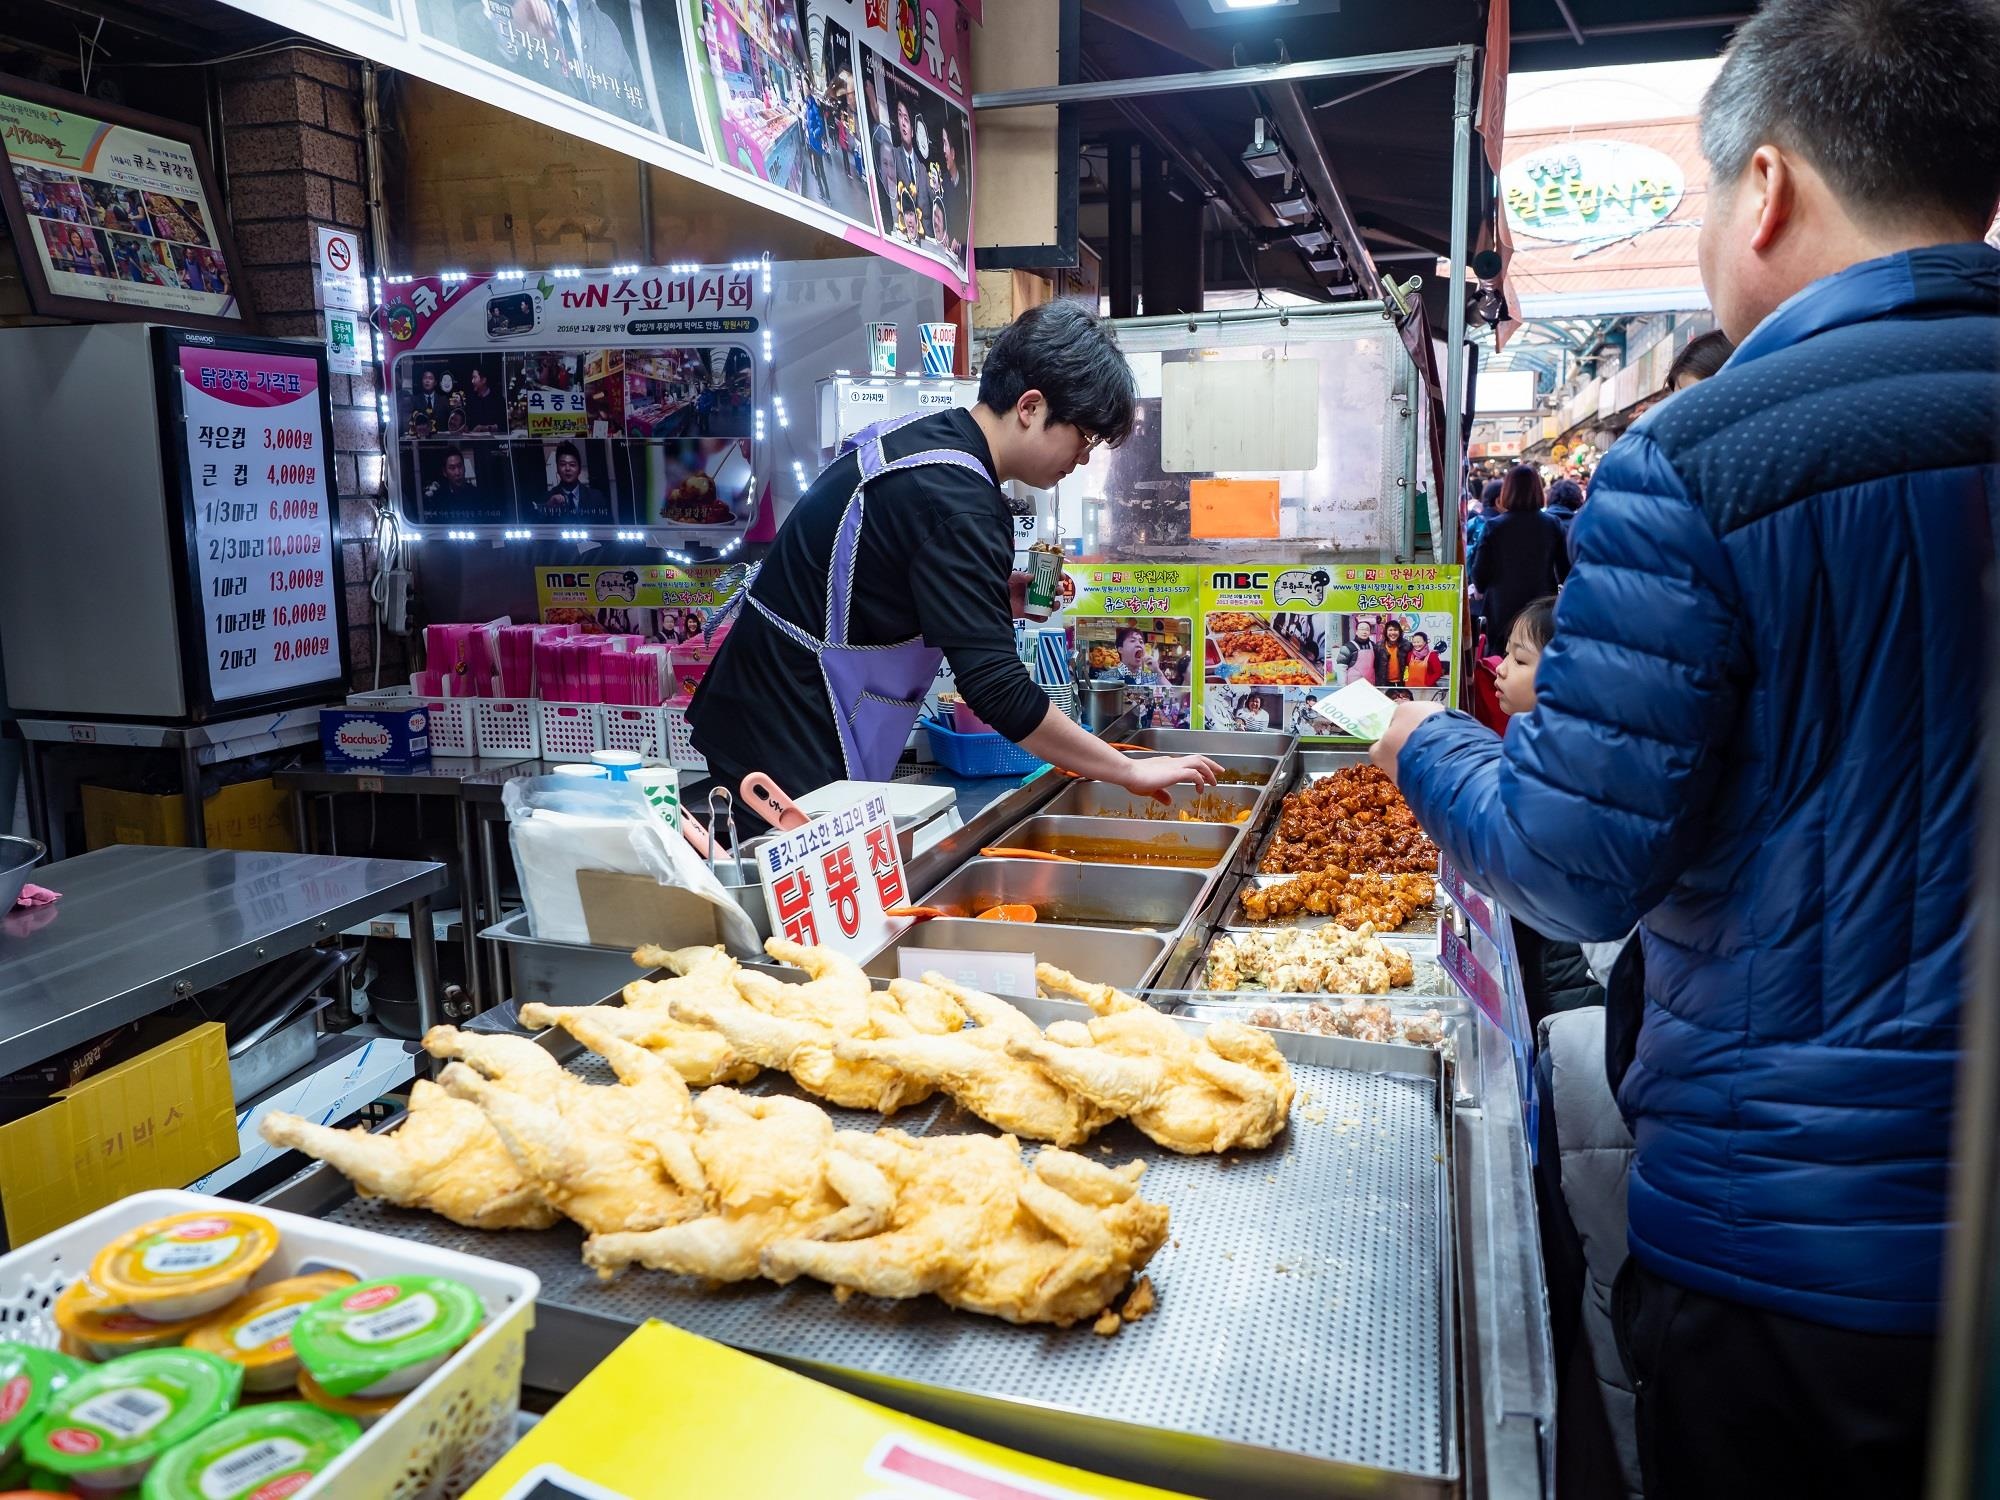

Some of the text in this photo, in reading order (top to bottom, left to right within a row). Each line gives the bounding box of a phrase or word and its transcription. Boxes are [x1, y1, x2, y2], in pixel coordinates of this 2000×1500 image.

[133, 154, 157, 170] 큐스
[160, 160, 193, 180] 닭강정
[1508, 178, 1674, 222] 월드컵시장
[561, 273, 753, 316] tvN 수요미식회
[185, 334, 213, 343] DAEWOO
[557, 324, 580, 333] 2016년
[581, 324, 595, 333] 12월
[597, 323, 611, 332] 28일
[201, 367, 301, 393] 닭강정 가격표
[862, 392, 884, 402] 2가지맛
[931, 395, 952, 405] 2가지맛
[198, 426, 313, 451] 작은컵 3,000원
[266, 464, 315, 486] 4,000원
[205, 500, 318, 526] 1/3마리 6,000원
[209, 536, 321, 564] 2/3마리 10,000원
[212, 569, 323, 598] 1마리 13,000원
[546, 573, 590, 588] MBC
[1134, 570, 1179, 583] 망원시장
[1212, 572, 1269, 589] MBC
[1390, 568, 1437, 580] 망원시장
[1281, 581, 1313, 594] 무한도전
[216, 603, 327, 635] 1마리반 16,000원
[220, 636, 329, 671] 2마리 20,000원
[833, 807, 865, 838] 최고의
[865, 796, 887, 823] 별미
